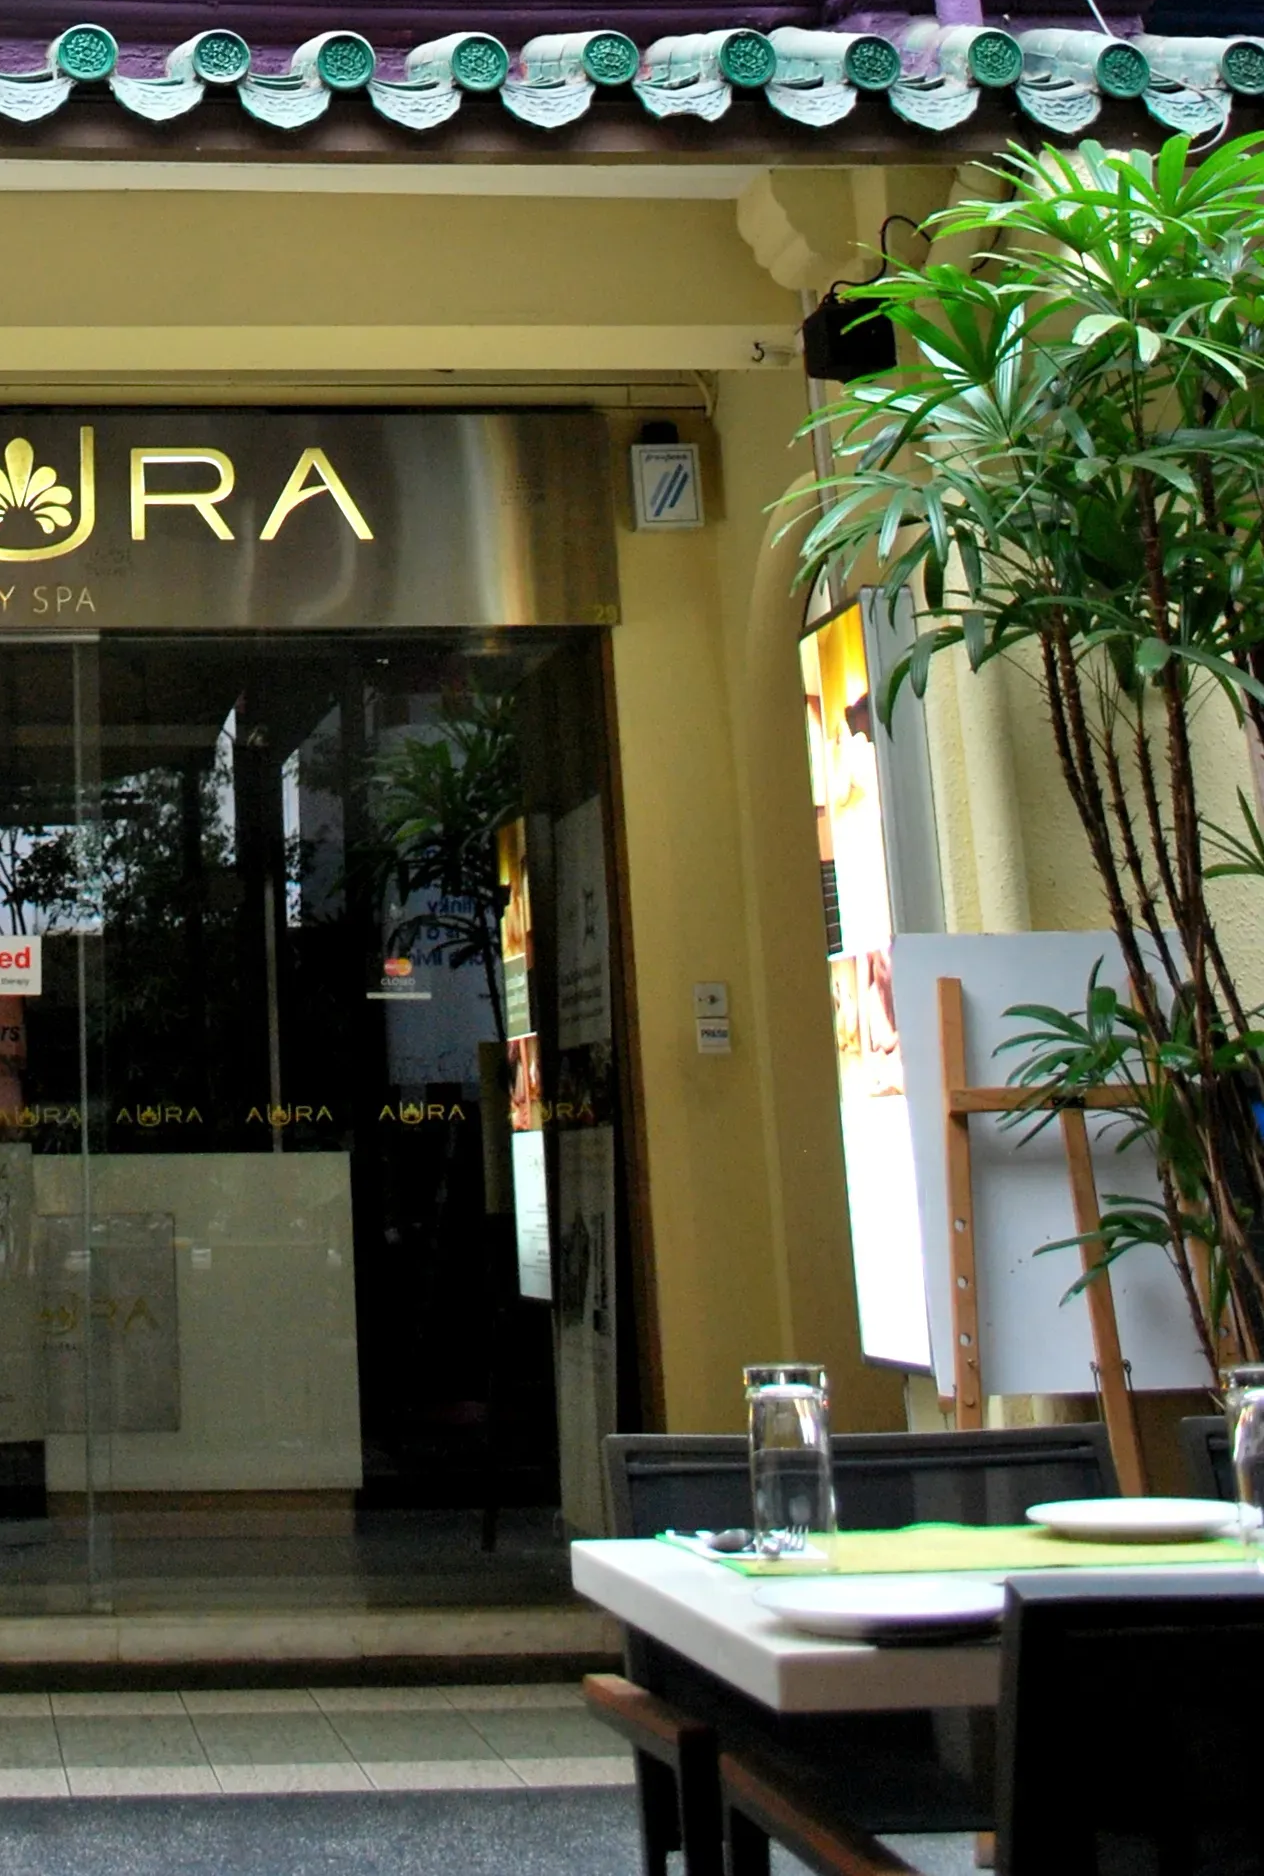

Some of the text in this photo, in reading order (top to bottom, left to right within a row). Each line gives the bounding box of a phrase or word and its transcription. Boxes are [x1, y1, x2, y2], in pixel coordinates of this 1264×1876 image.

[32, 585, 96, 614] SPA
[116, 1104, 204, 1128] AURA
[244, 1101, 334, 1126] AURA
[378, 1101, 467, 1125] AURA
